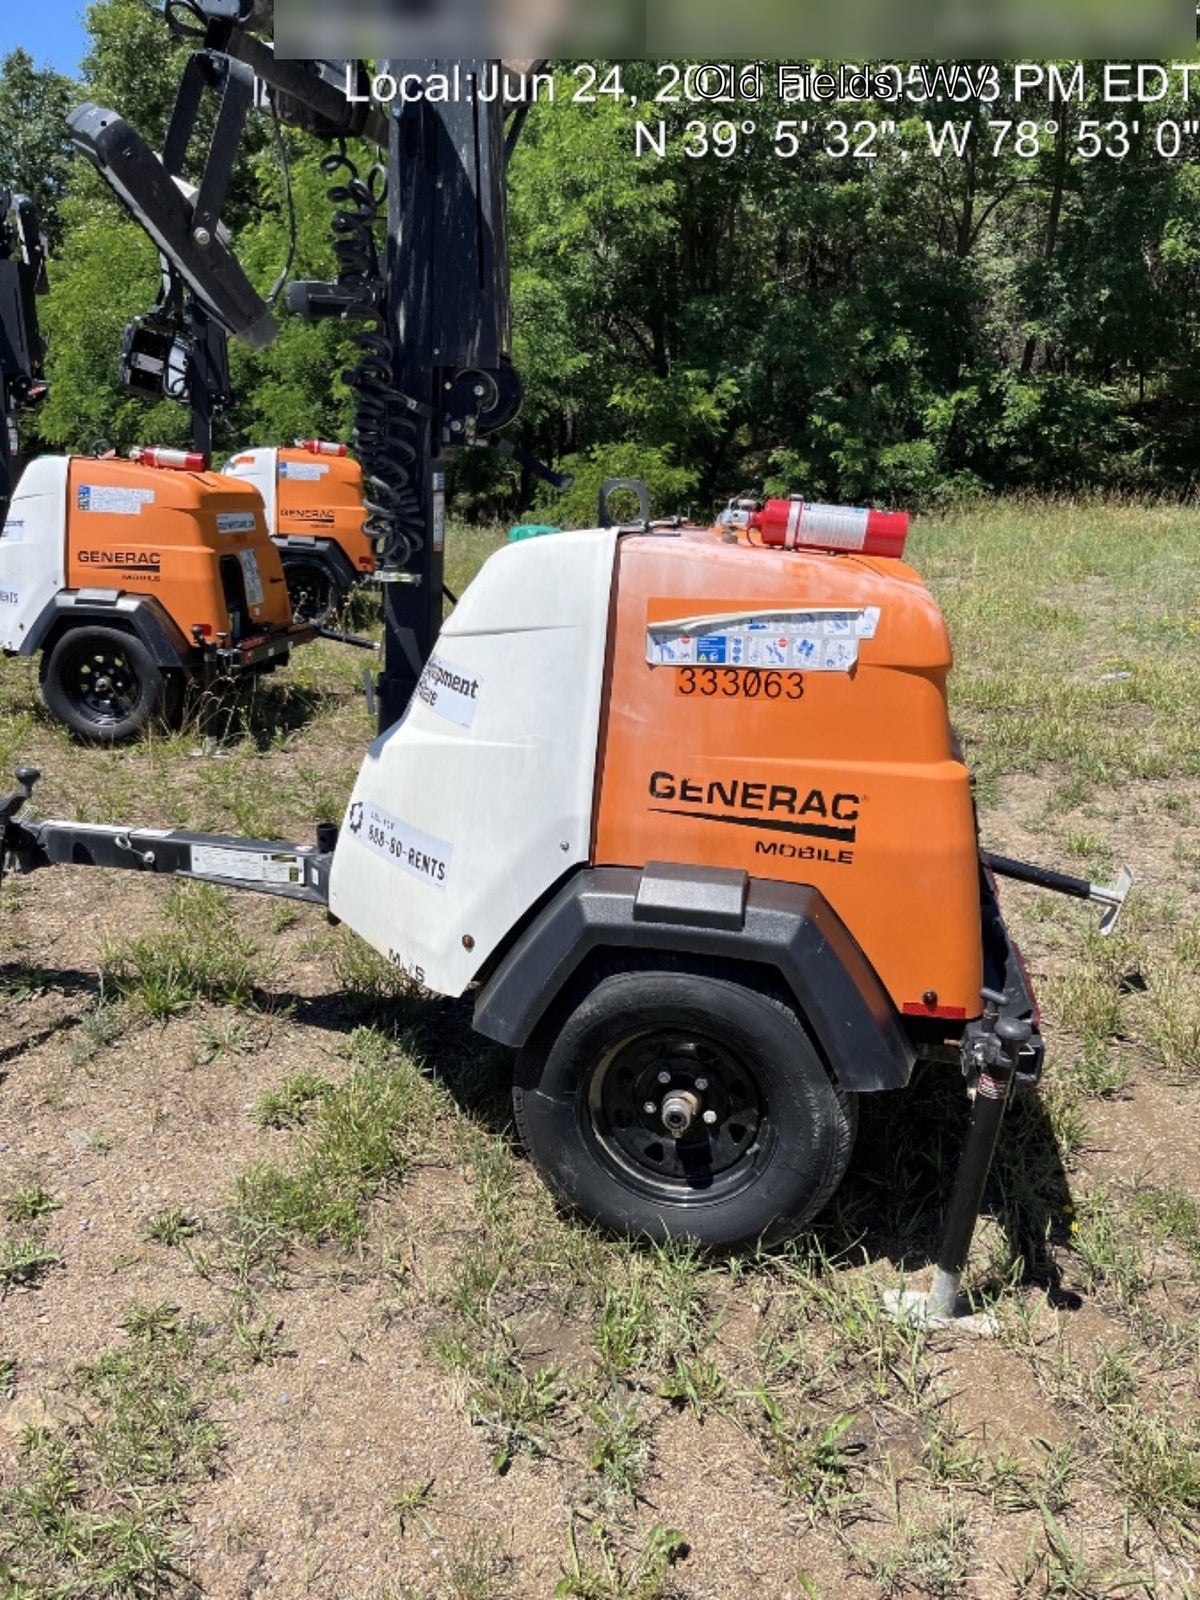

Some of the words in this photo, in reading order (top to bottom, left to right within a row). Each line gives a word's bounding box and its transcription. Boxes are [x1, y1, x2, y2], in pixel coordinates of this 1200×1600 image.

[77, 550, 161, 565] GENERAC
[677, 667, 806, 700] 333063
[648, 770, 860, 821] GENERAC
[754, 840, 854, 865] MOBILE
